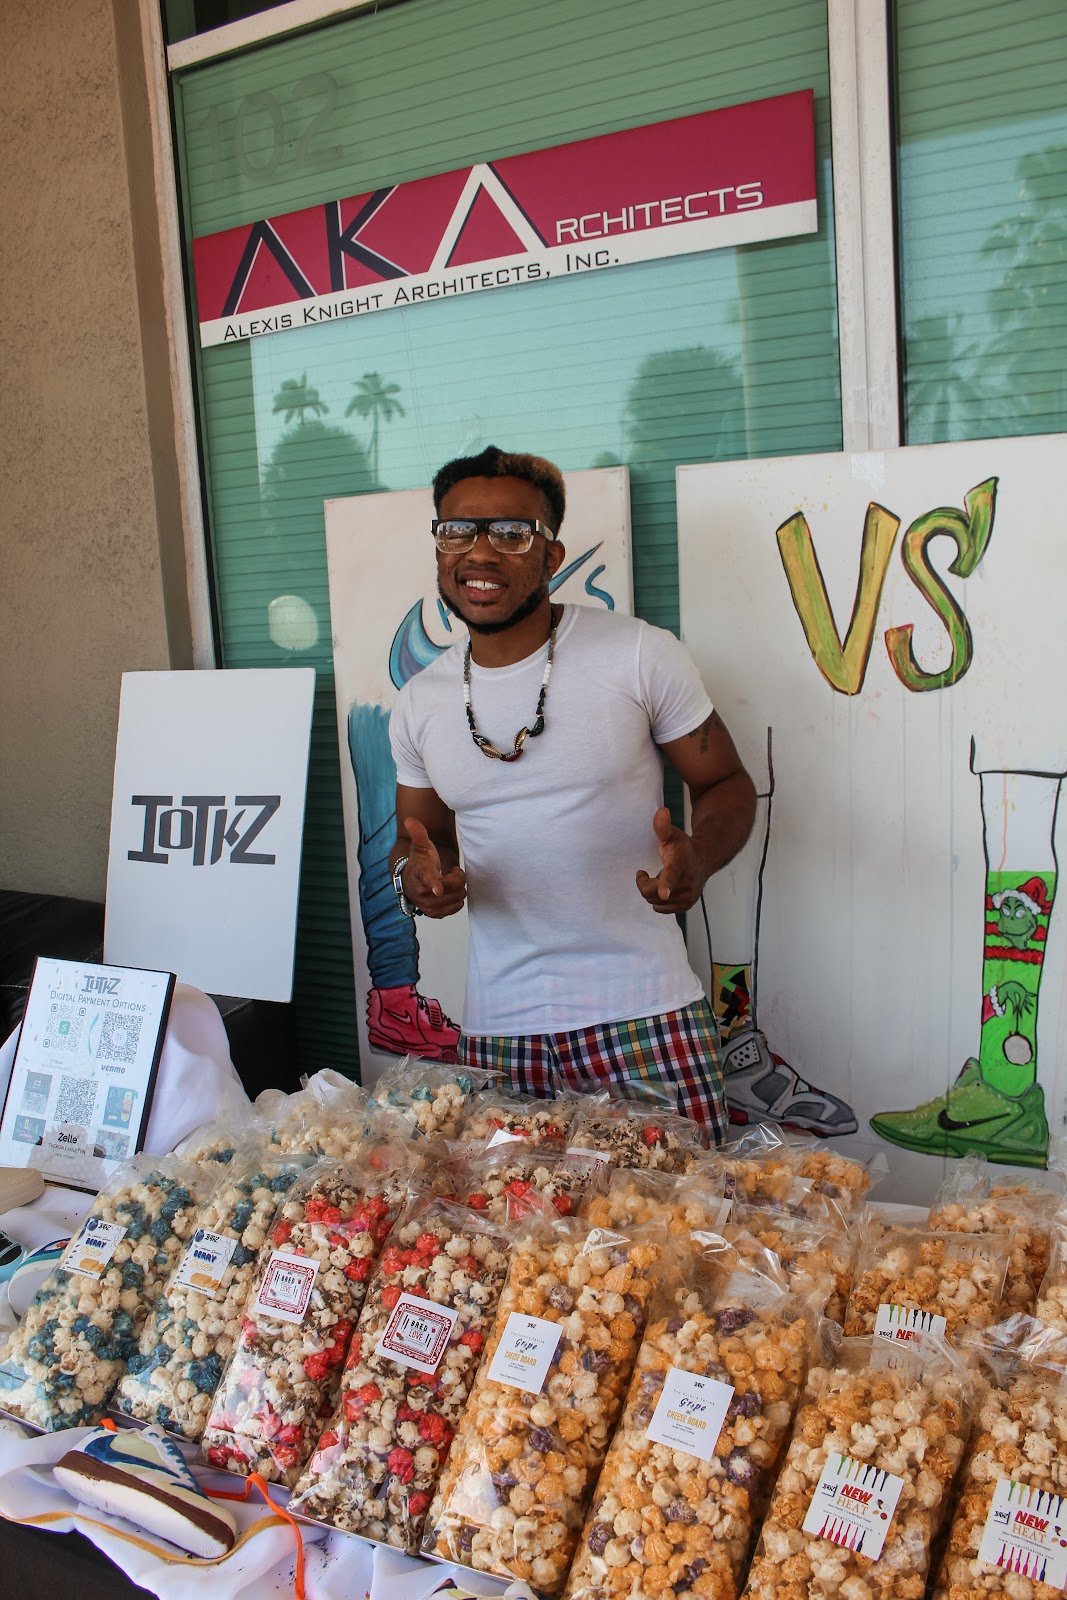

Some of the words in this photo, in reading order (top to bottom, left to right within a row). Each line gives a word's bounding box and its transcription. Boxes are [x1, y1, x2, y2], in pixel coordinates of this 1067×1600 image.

[101, 1064, 126, 1075] venmo
[57, 1131, 79, 1145] Zelle
[666, 1409, 688, 1425] CHEESE
[688, 1415, 708, 1431] BOARD
[839, 1482, 874, 1503] NEW
[836, 1496, 870, 1516] HEAT
[1013, 1510, 1050, 1530] NEW
[1010, 1523, 1048, 1544] HEAT
